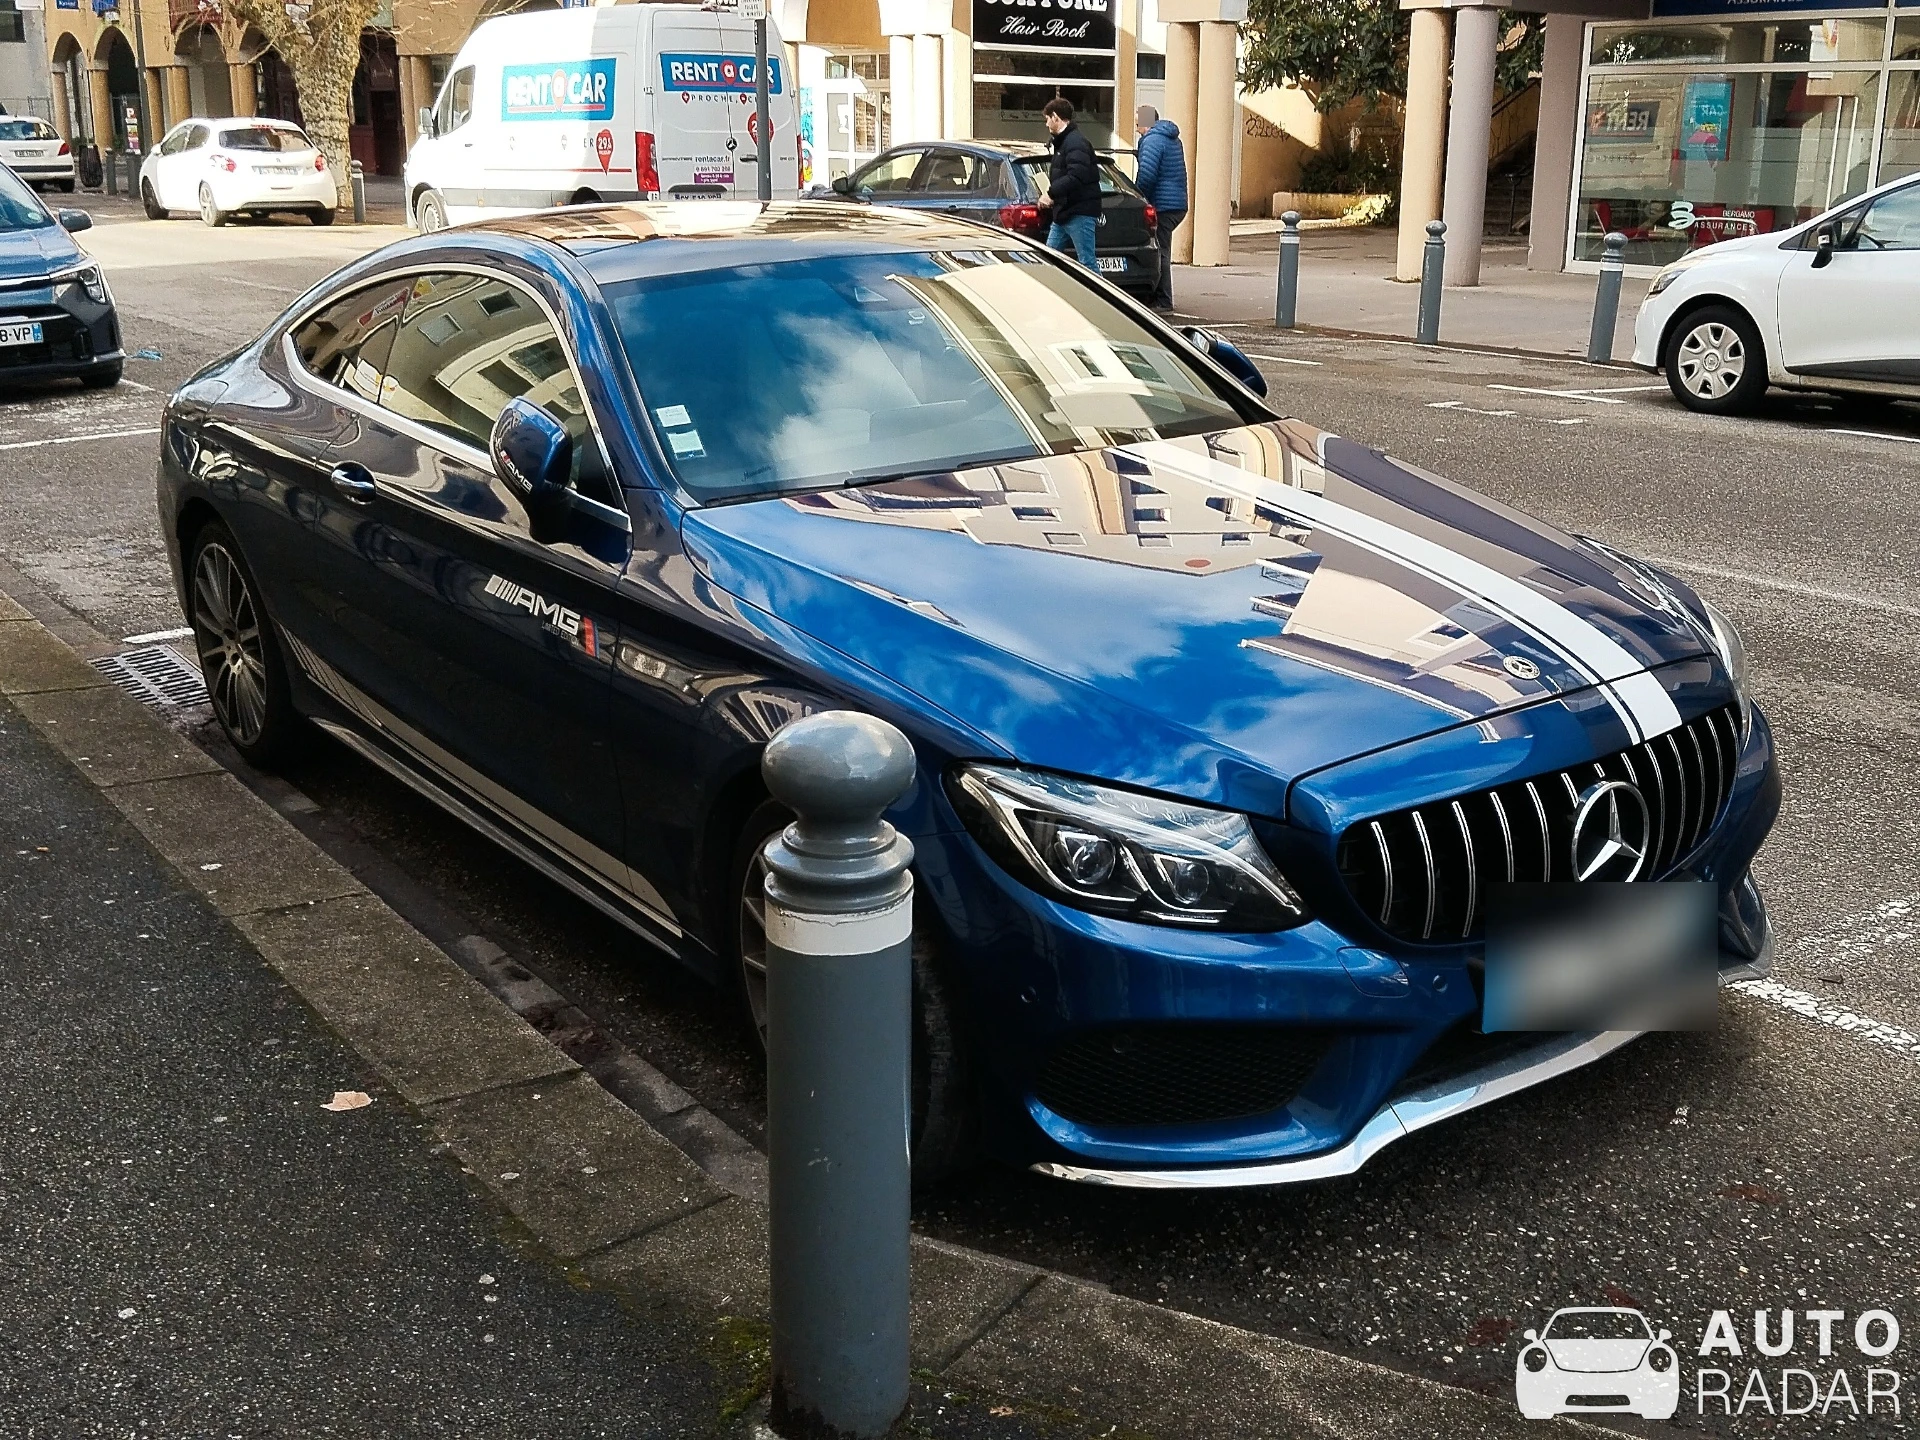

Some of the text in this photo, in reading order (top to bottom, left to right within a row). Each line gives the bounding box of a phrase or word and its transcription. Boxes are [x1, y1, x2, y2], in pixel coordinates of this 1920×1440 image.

[1000, 16, 1090, 38] Hair Rock
[670, 61, 719, 82] RENT
[507, 73, 552, 106] RENT
[567, 72, 607, 104] CAR
[694, 155, 730, 163] rentacar.fr
[1722, 209, 1755, 218] BERGAMO
[1694, 221, 1754, 231] ASSURANCES
[507, 461, 533, 491] AMG
[514, 587, 581, 635] AMG
[541, 620, 579, 648] LIMITED EDITION
